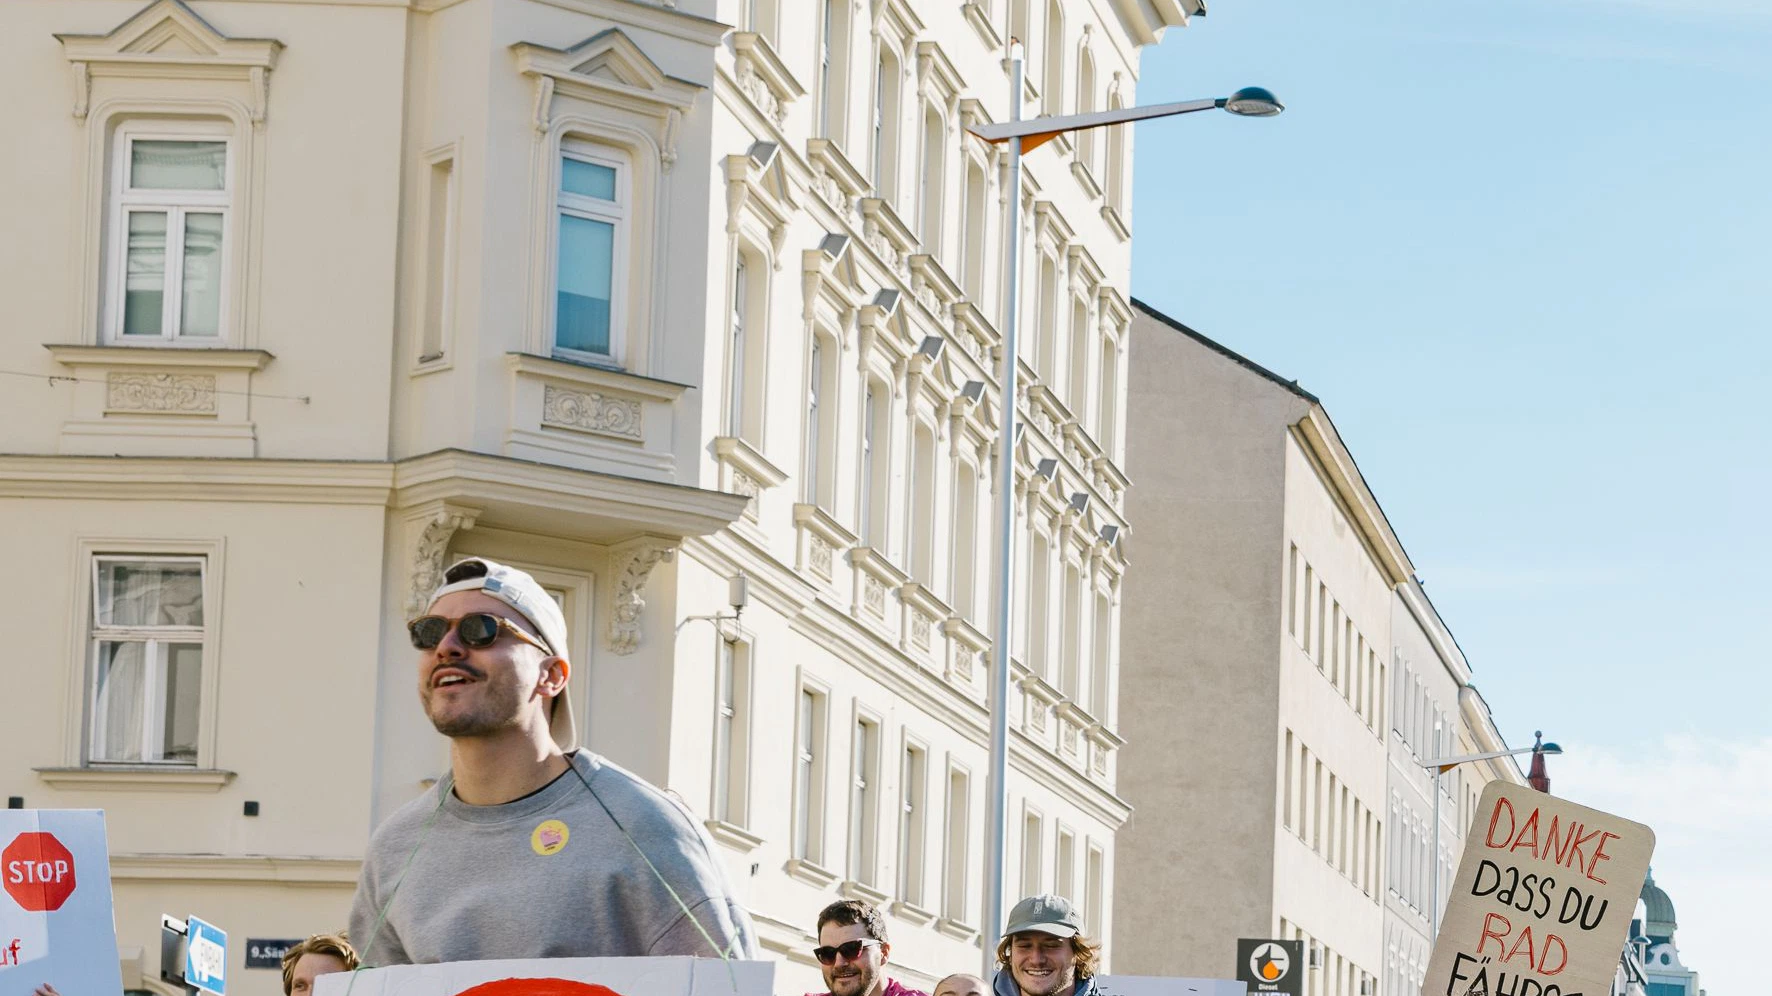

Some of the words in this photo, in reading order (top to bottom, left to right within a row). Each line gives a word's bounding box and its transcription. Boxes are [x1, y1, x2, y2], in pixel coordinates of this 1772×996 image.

[1485, 797, 1621, 885] DANKE
[9, 861, 68, 884] STOP
[1558, 886, 1609, 931] DU
[1476, 912, 1568, 976] RAD
